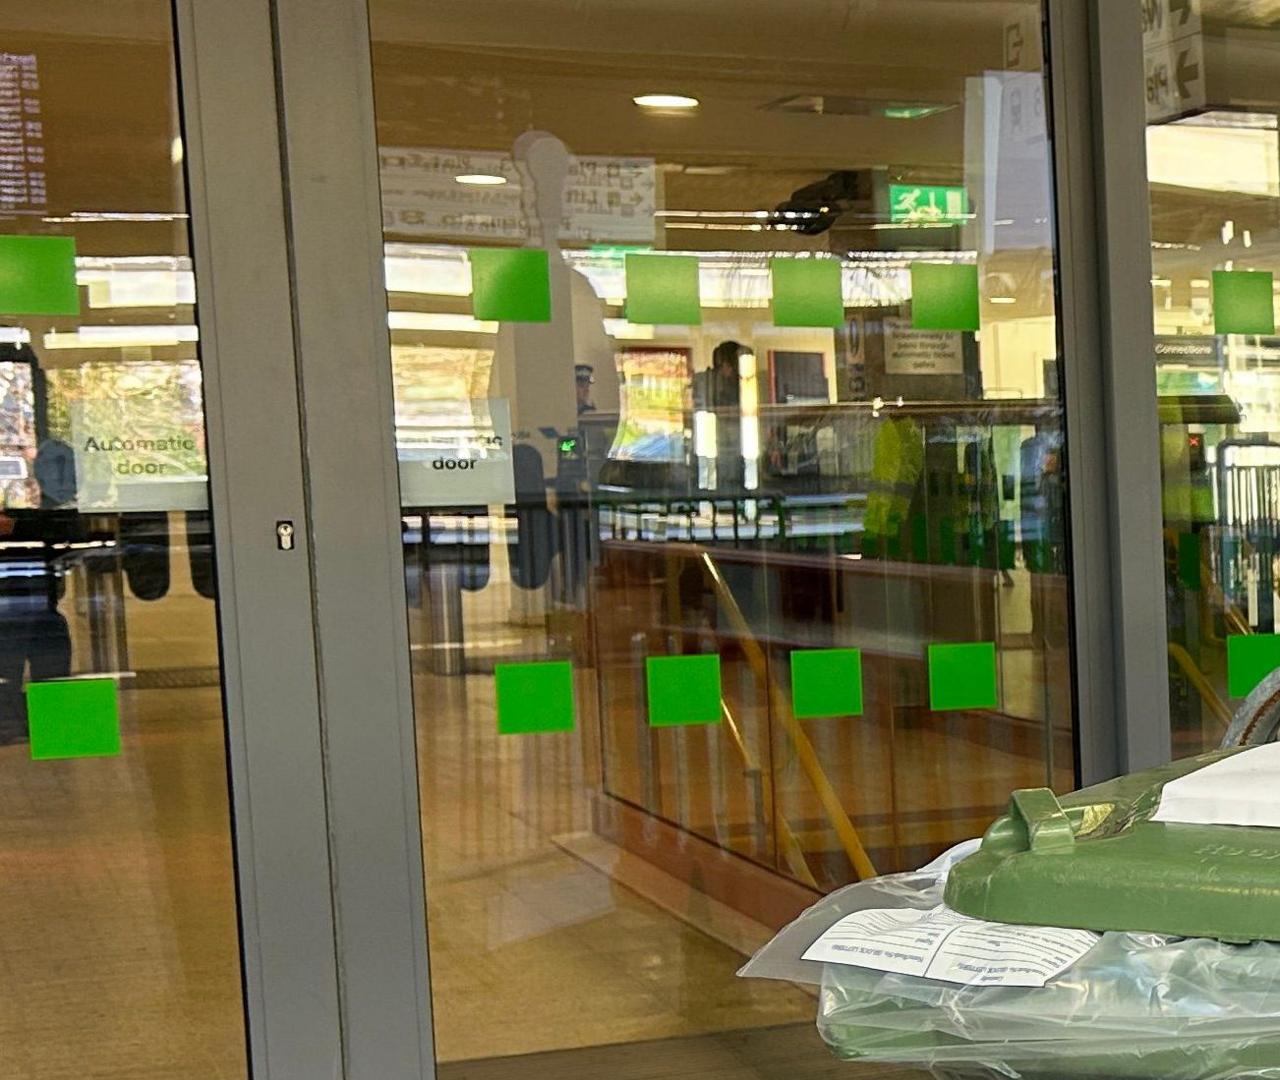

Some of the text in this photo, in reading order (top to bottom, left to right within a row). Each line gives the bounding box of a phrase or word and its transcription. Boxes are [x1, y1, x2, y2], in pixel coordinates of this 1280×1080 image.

[84, 436, 195, 452] Automatic
[117, 460, 168, 475] door
[432, 457, 477, 470] door
